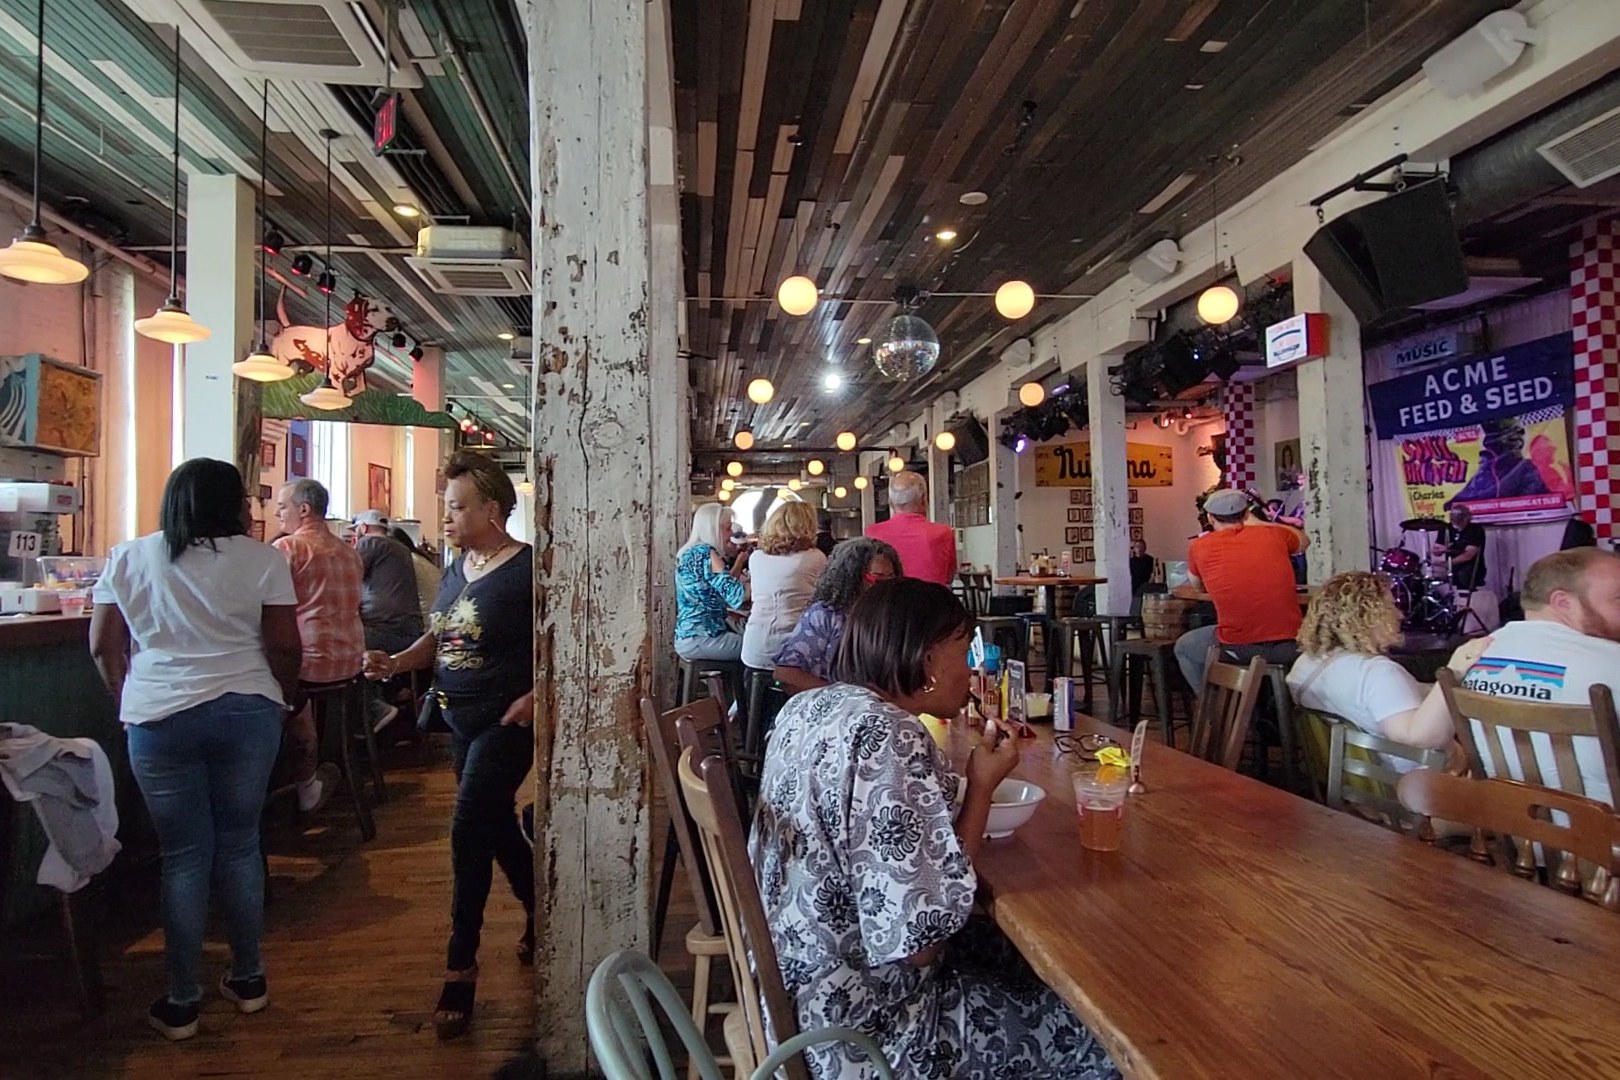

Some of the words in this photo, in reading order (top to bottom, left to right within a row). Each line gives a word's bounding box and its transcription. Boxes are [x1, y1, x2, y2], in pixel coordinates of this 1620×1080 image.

[1396, 340, 1448, 364] MUSIC
[1424, 355, 1508, 397] ACME
[1398, 399, 1453, 427] FEED
[1460, 393, 1479, 415] &
[1485, 376, 1553, 409] SEED
[1413, 490, 1445, 501] Charles
[16, 533, 36, 551] 113
